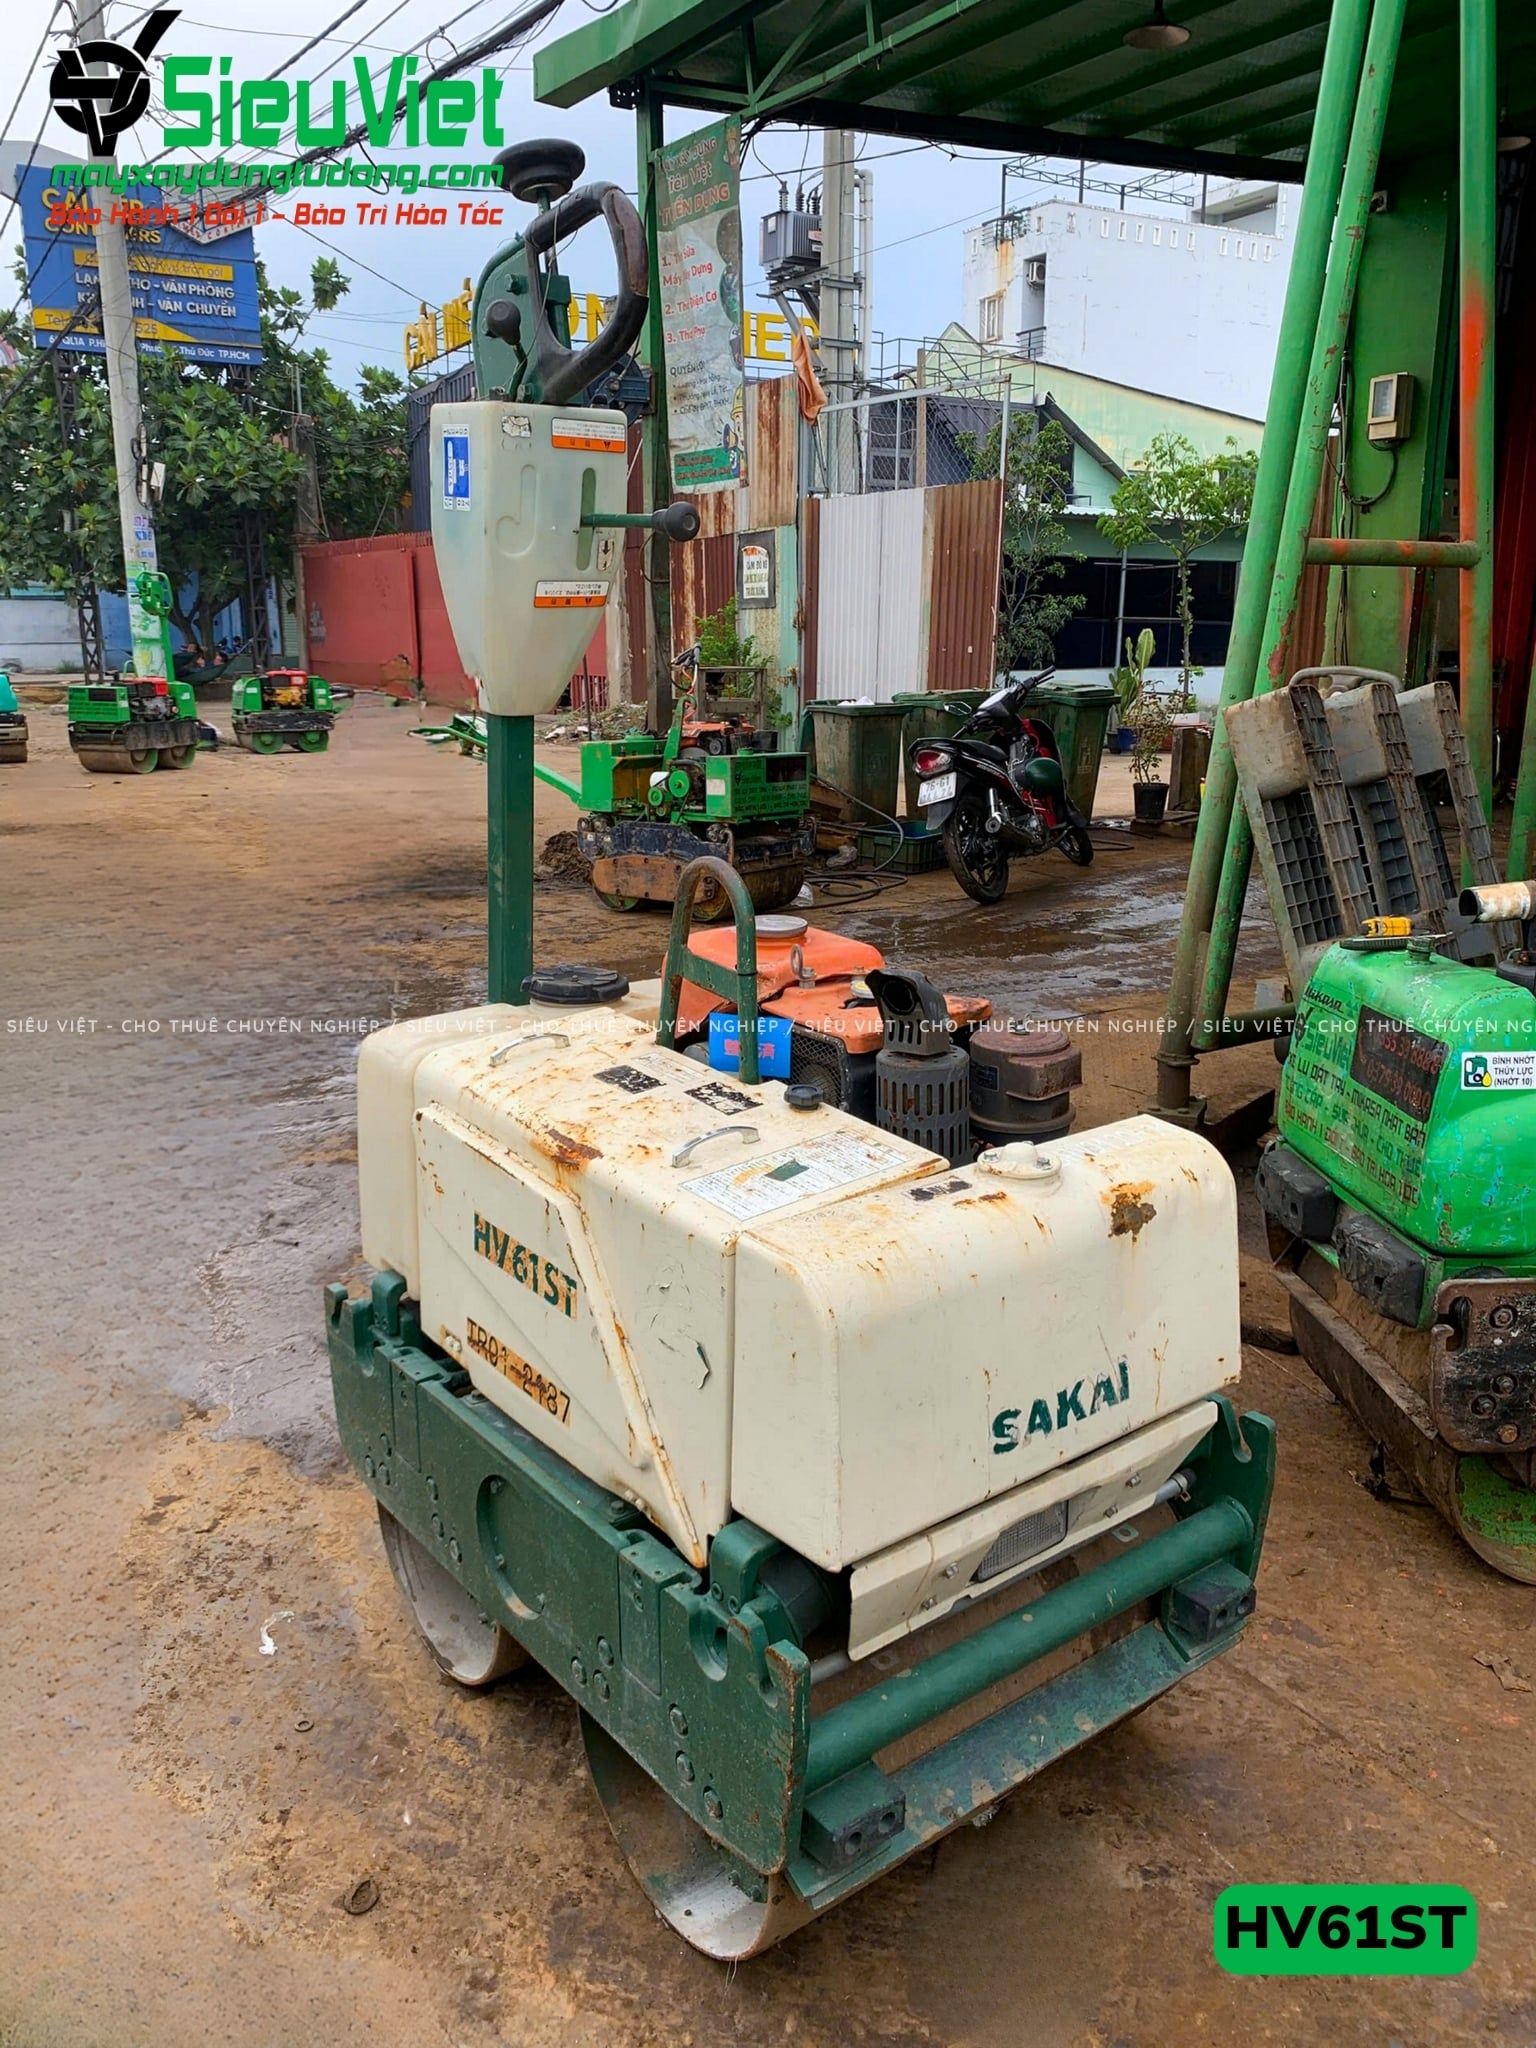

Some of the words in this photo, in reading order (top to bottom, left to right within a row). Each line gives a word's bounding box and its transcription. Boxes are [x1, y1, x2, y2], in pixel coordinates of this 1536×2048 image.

[189, 281, 235, 299] PHÒNG
[1522, 1077, 1533, 1087] 10)
[473, 1212, 577, 1319] HV61ST
[991, 1358, 1130, 1455] SAKAI
